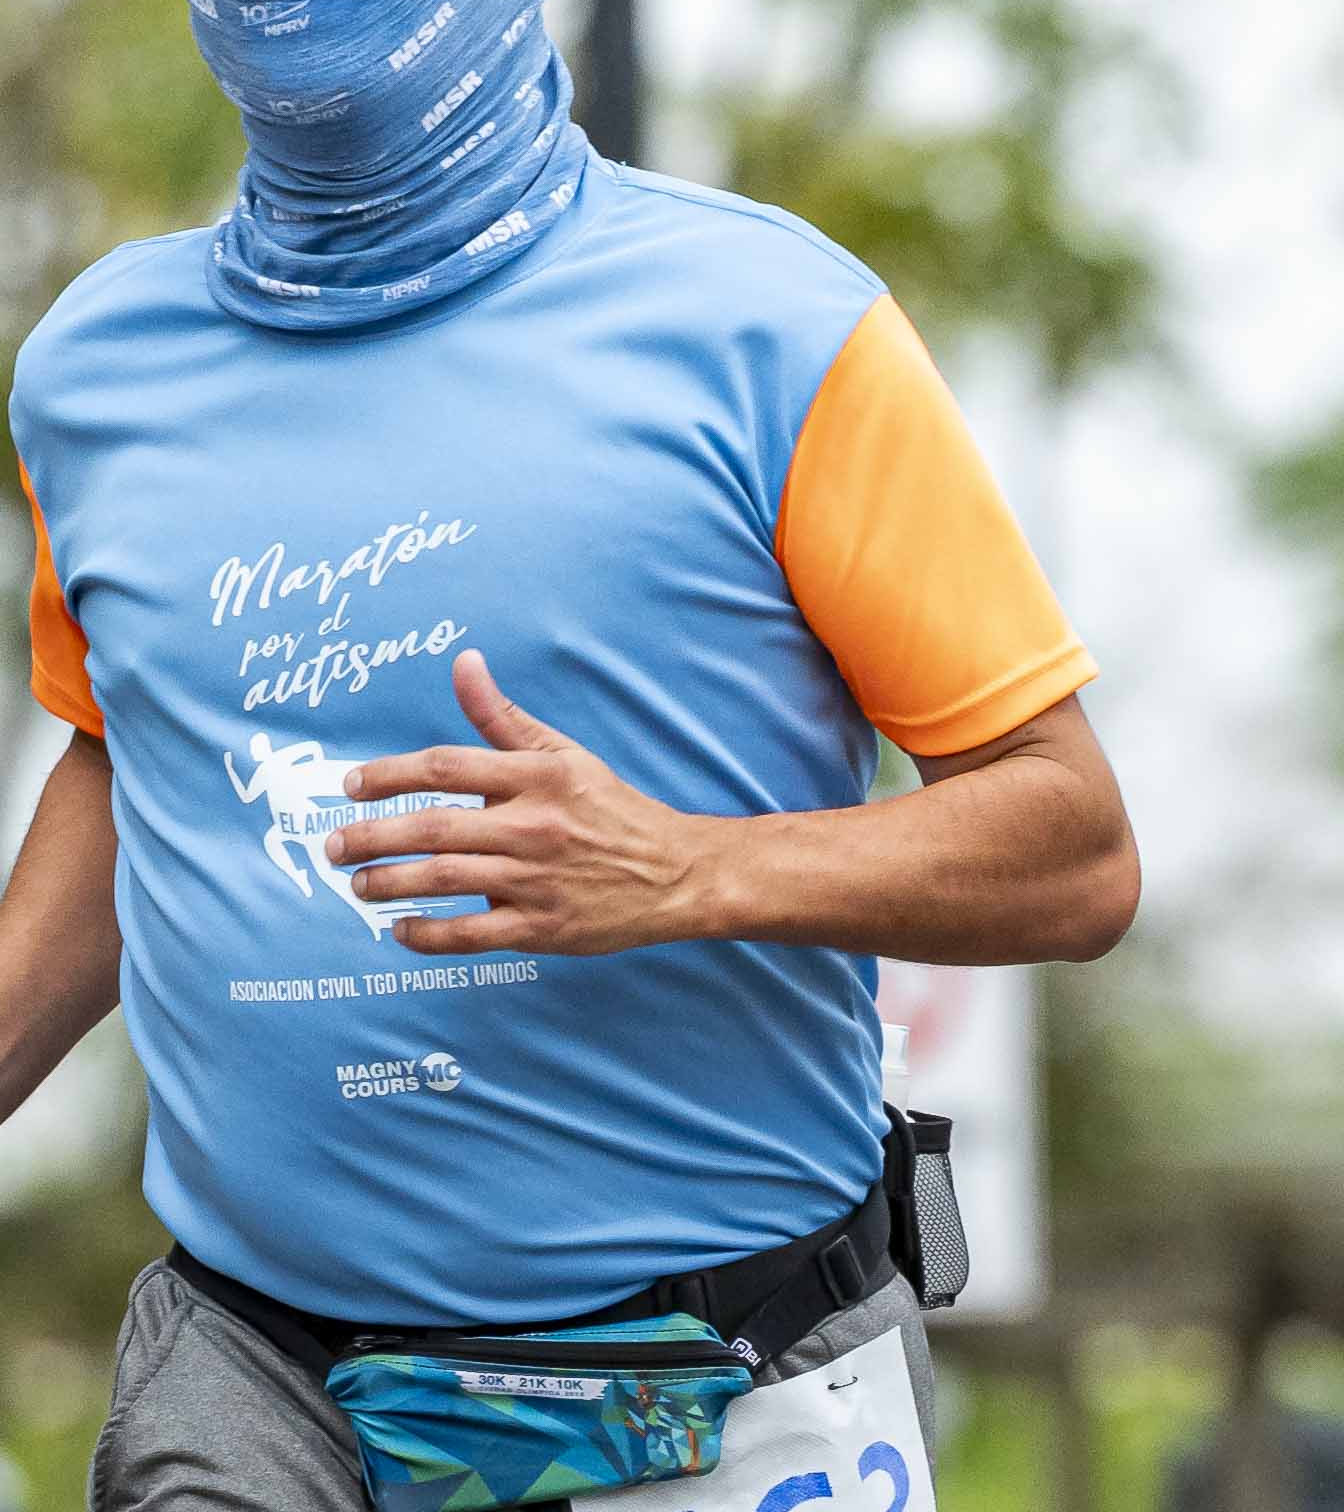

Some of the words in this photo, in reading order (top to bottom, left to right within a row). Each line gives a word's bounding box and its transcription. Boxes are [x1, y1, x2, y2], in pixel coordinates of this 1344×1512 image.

[389, 1, 456, 72] MSR
[421, 70, 484, 133] MSR
[463, 210, 532, 256] MSR
[209, 510, 478, 626] Maratón
[239, 631, 304, 677] por
[318, 592, 351, 635] el
[243, 619, 468, 712] autismo
[279, 812, 300, 835] EL
[229, 981, 314, 1002] ASOCIACION
[317, 976, 360, 1000] CIVIL
[363, 972, 398, 995] TGD
[402, 966, 469, 992] PADRES
[473, 960, 538, 986] UNIDOS
[336, 1059, 417, 1082] MAGNY
[342, 1076, 421, 1100] COURS
[479, 1374, 506, 1386] 30K
[519, 1377, 547, 1389] 21K
[557, 1379, 584, 1391] 10K
